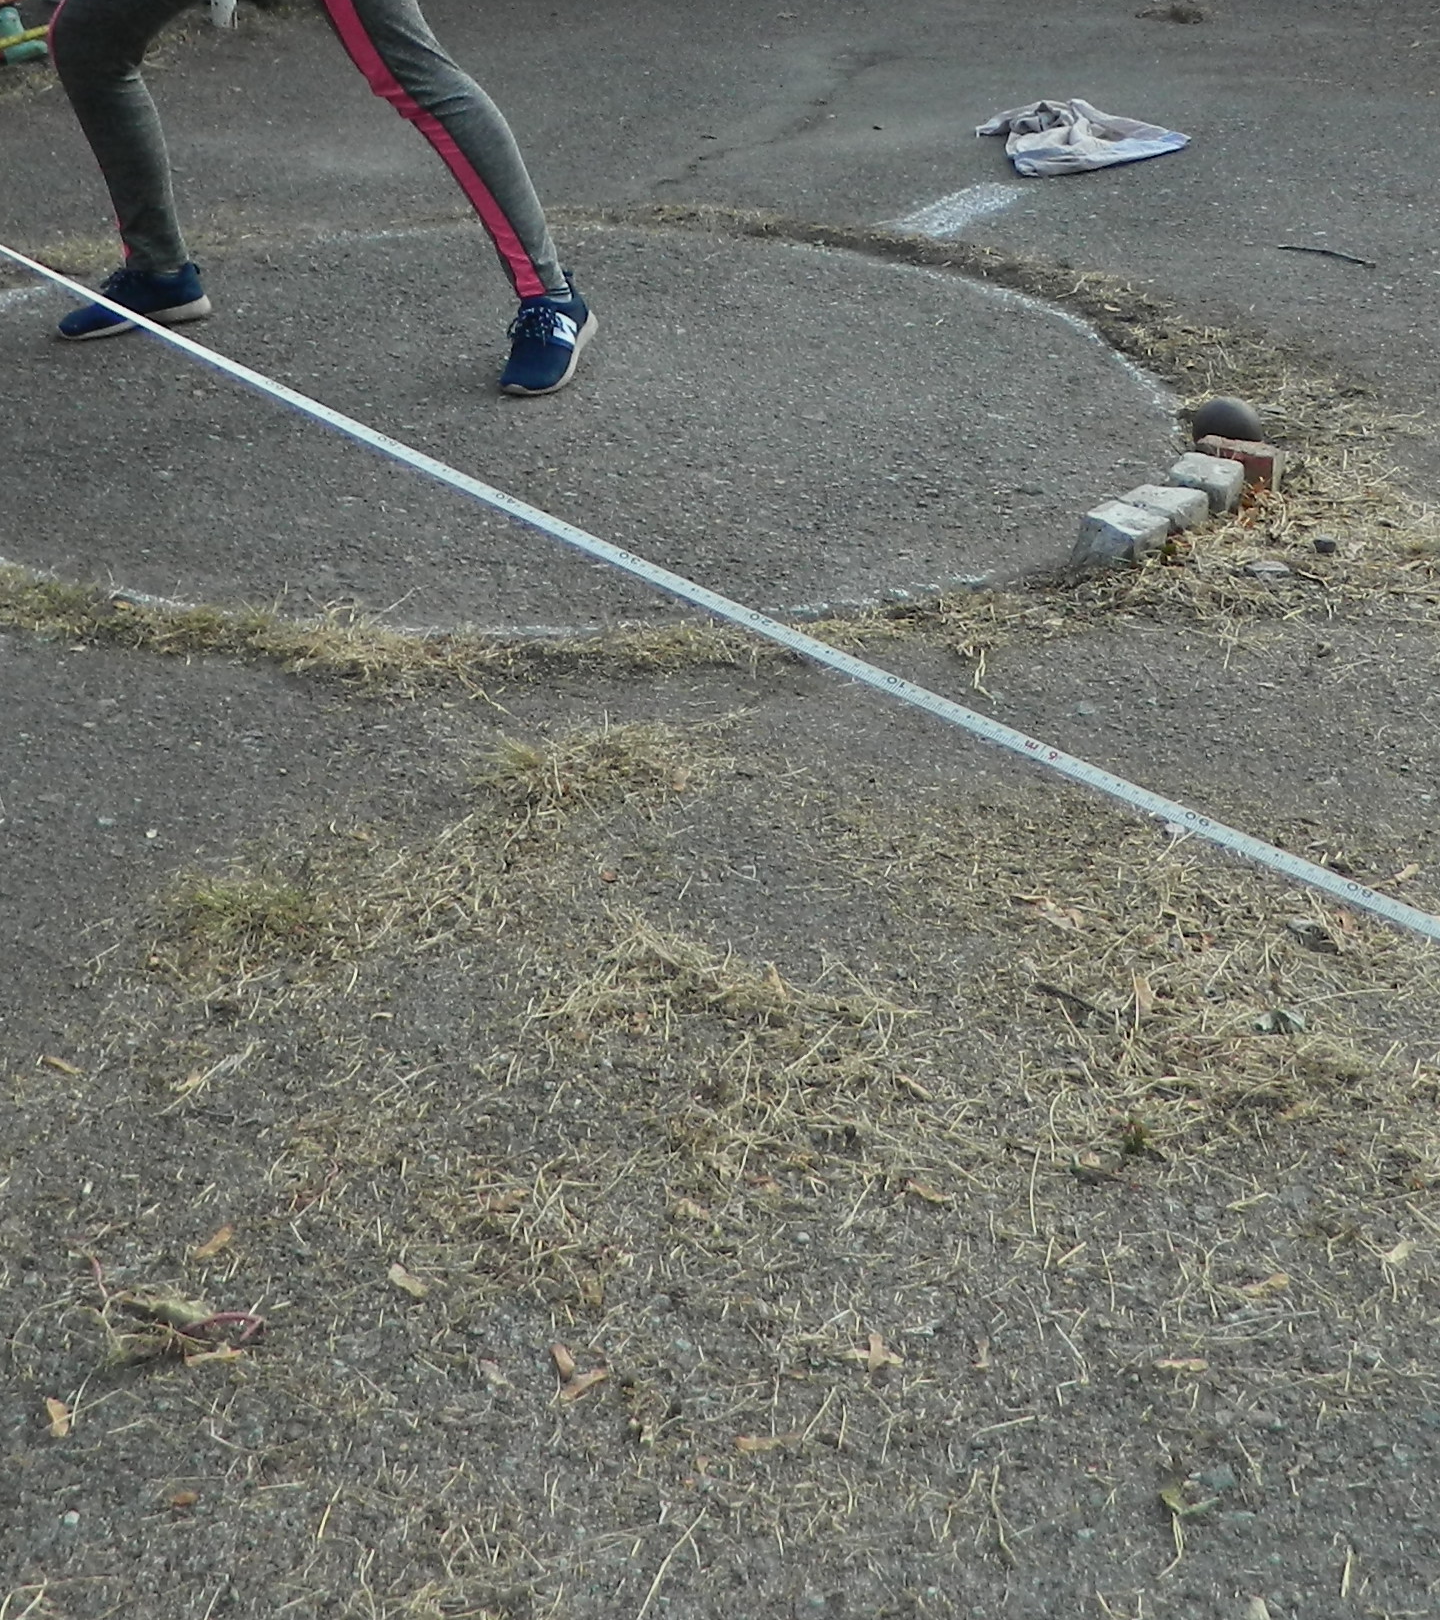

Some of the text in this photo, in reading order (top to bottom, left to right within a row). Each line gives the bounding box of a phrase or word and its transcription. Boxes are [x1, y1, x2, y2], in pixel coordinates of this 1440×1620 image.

[749, 612, 772, 627] 20
[886, 675, 905, 689] 10
[1024, 740, 1038, 752] m
[1048, 750, 1058, 761] 6
[1184, 811, 1209, 827] 90
[1346, 882, 1372, 899] 80
